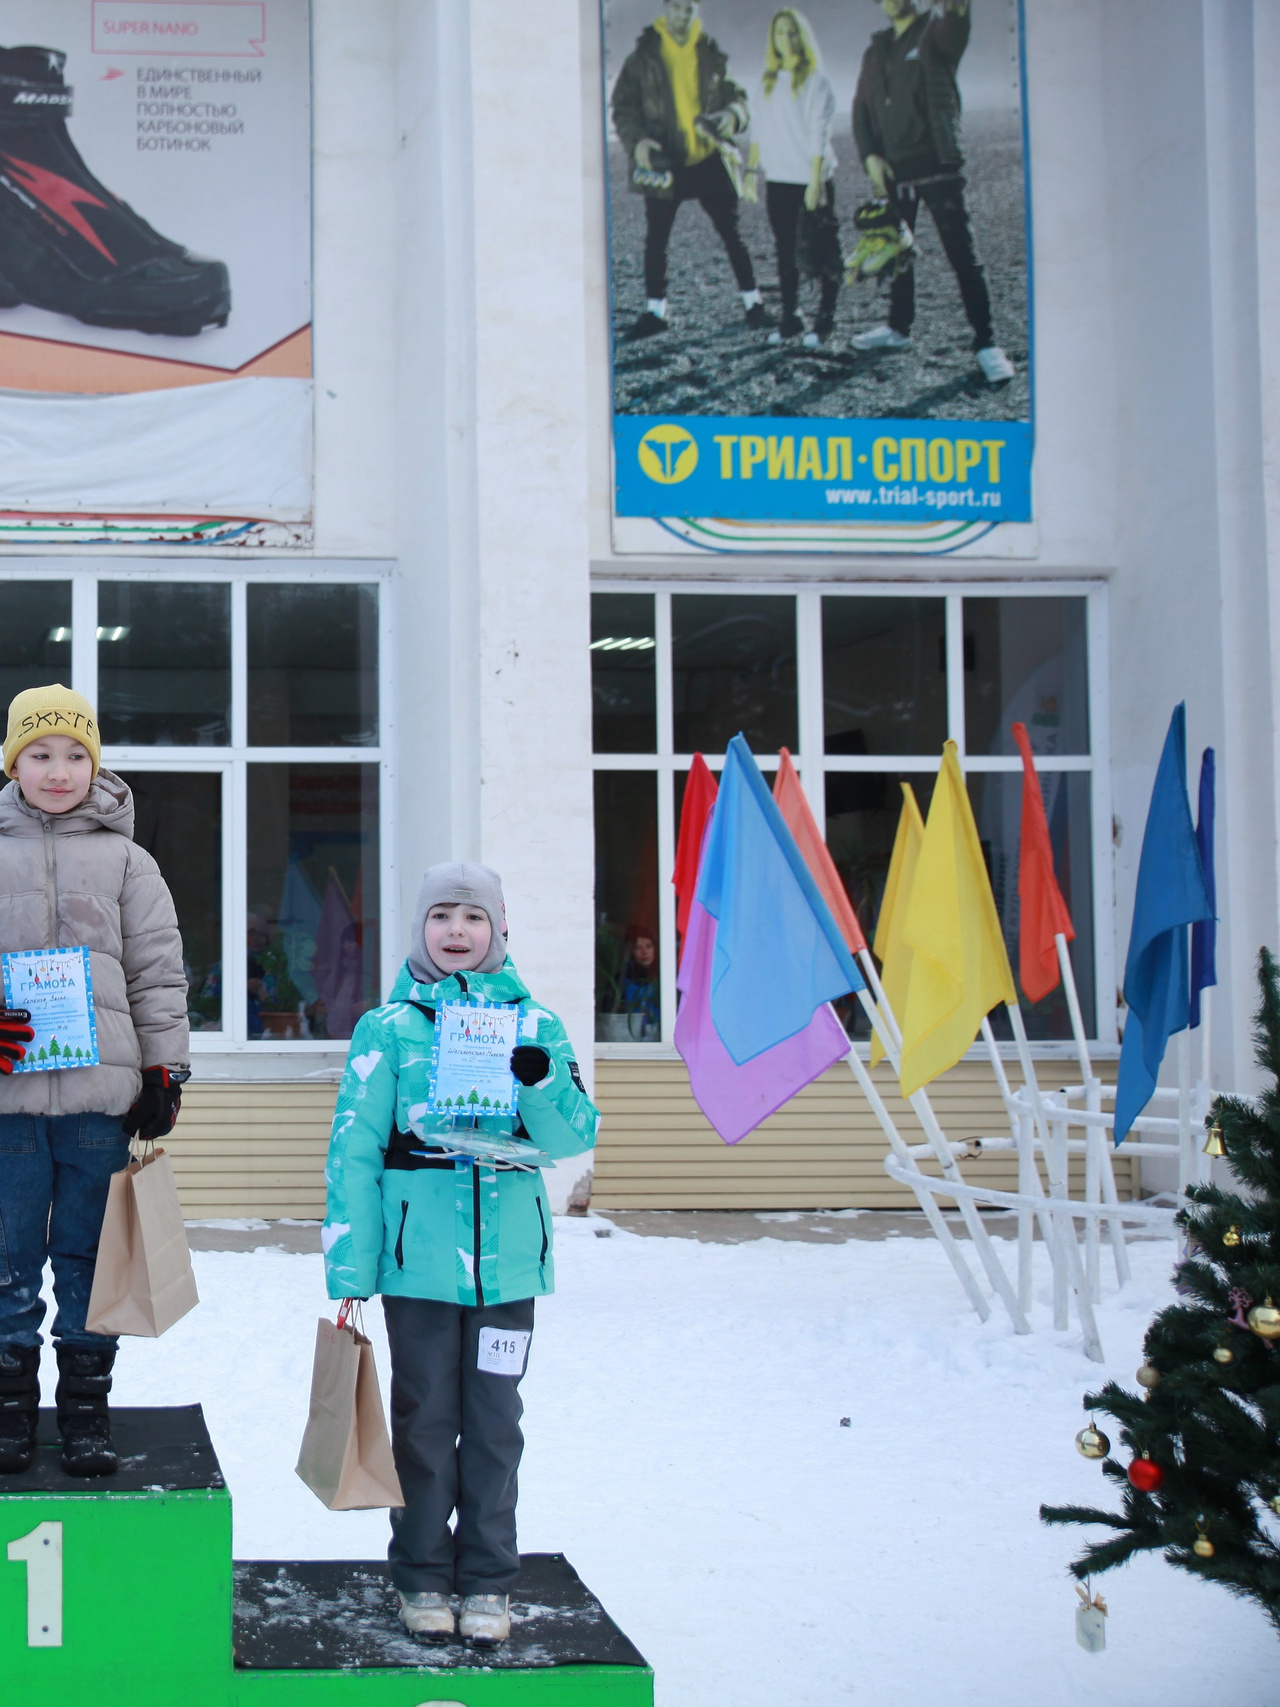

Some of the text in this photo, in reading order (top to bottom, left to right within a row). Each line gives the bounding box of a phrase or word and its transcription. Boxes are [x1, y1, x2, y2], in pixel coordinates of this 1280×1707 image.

[103, 20, 198, 36] SUPER NANO
[137, 67, 262, 83] ЕДИНСТВЕННЫЙ
[137, 86, 192, 100] В МИРЕ
[137, 102, 236, 118] ПОЛНОСТЬЮ
[136, 120, 244, 135] КАРБОНОВЫЙ
[137, 138, 211, 152] БОТИНОК
[826, 486, 1001, 510] www.trial-sport.ru
[20, 978, 76, 991] ГРАМОТА
[450, 1032, 506, 1045] ГРАМОТА
[491, 1339, 516, 1353] 415
[7, 1521, 63, 1647] 1
